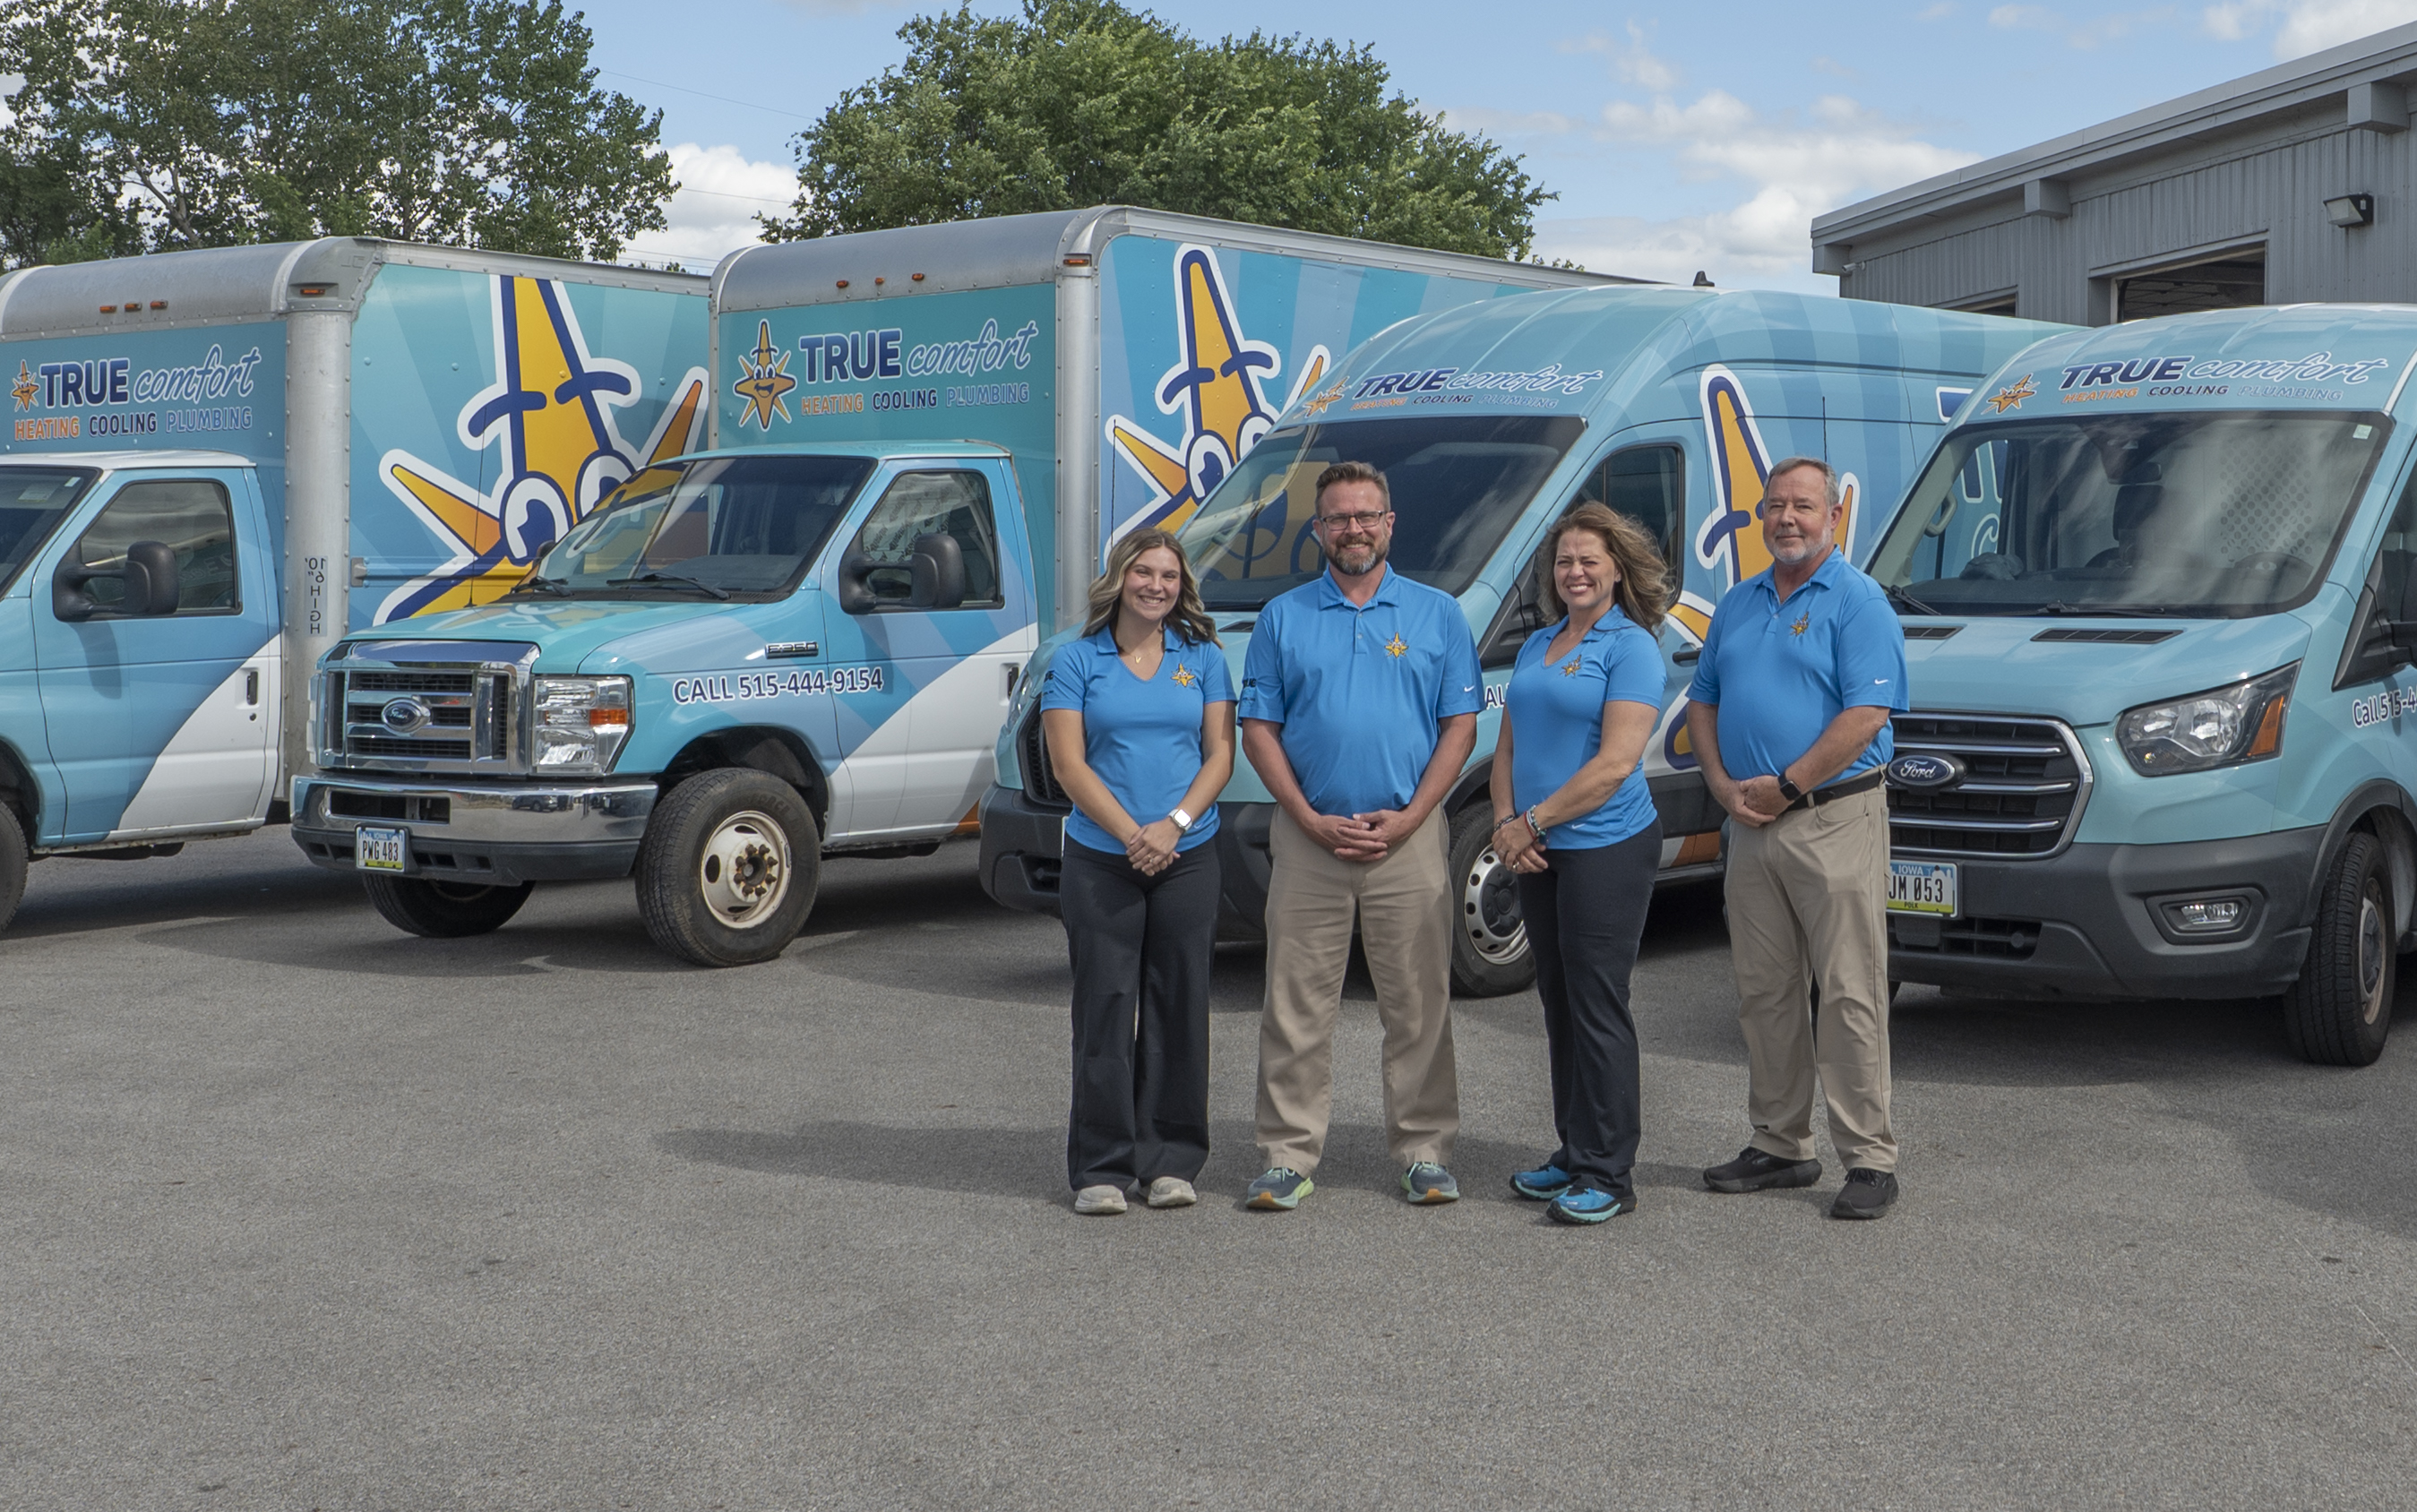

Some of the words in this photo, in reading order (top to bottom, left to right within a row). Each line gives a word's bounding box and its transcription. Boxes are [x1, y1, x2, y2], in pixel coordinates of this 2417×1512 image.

[799, 328, 902, 383] TRUE
[907, 318, 1038, 377] comfort
[40, 358, 130, 408] TRUE
[133, 344, 262, 403] comfort
[1352, 367, 1459, 401] TRUE
[1446, 363, 1604, 395] comfort
[2059, 355, 2195, 391] TRUE
[2187, 351, 2388, 384] comfort
[801, 395, 864, 417] HEATING
[872, 390, 937, 411] COOLING
[946, 383, 1029, 408] PLUMBING
[1413, 394, 1474, 406] COOLING
[1478, 394, 1559, 409] PLUMBING
[2062, 387, 2138, 404] HEATING
[2147, 384, 2229, 397] COOLING
[2237, 384, 2344, 402] PLUMBING
[14, 417, 80, 442] HEATING
[89, 412, 157, 436] COOLING
[166, 407, 253, 434] PLUMBING
[674, 675, 735, 705] CALL
[738, 666, 883, 699] 515-444-9154
[1484, 683, 1510, 709] AL
[2352, 695, 2379, 727] Call
[2379, 684, 2417, 721] 515-4
[1900, 760, 1937, 778] Ford
[363, 840, 380, 860] PWG
[383, 841, 399, 862] 483
[1898, 864, 1924, 876] IOWA
[1888, 875, 1906, 900] JM
[1914, 877, 1943, 904] 053
